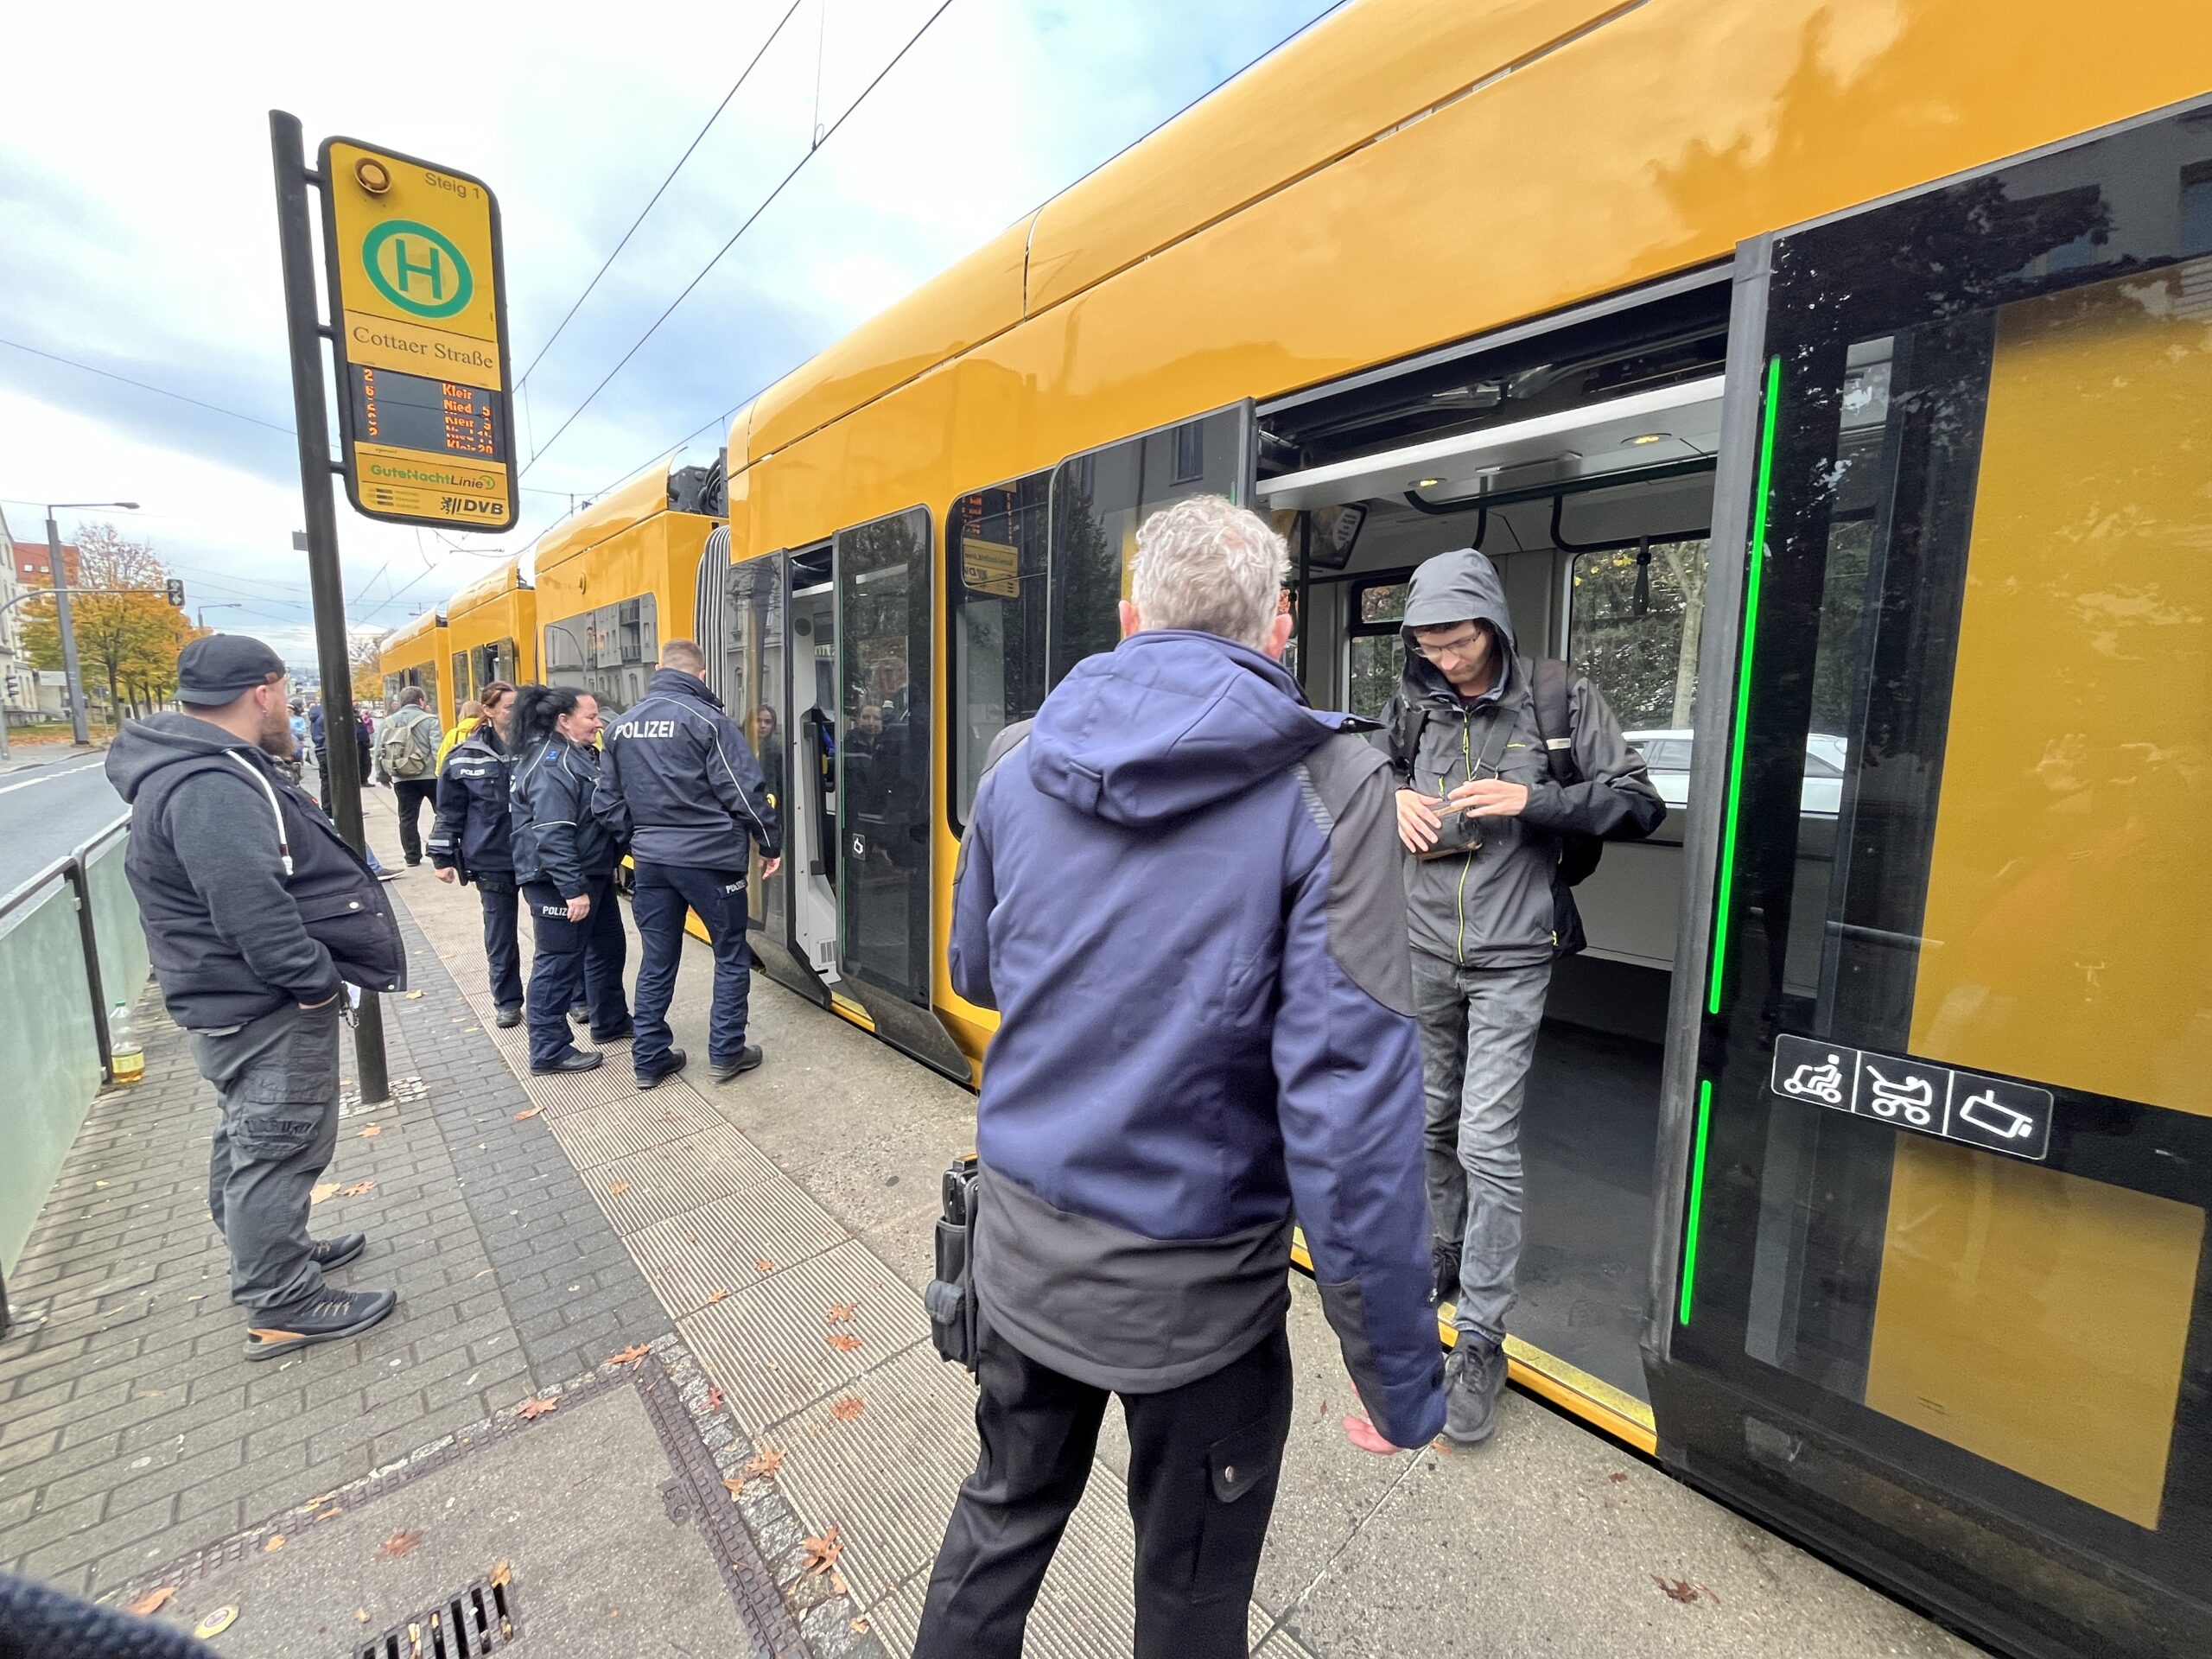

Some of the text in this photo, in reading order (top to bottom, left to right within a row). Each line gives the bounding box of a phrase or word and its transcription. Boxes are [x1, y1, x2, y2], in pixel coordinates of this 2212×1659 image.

[425, 172, 479, 200] Steig 1
[395, 238, 442, 301] H
[353, 326, 493, 369] Cottaer Straße
[364, 368, 374, 382] 2
[443, 399, 473, 414] Nied
[463, 499, 504, 516] DVB
[613, 720, 675, 741] POLIZEI
